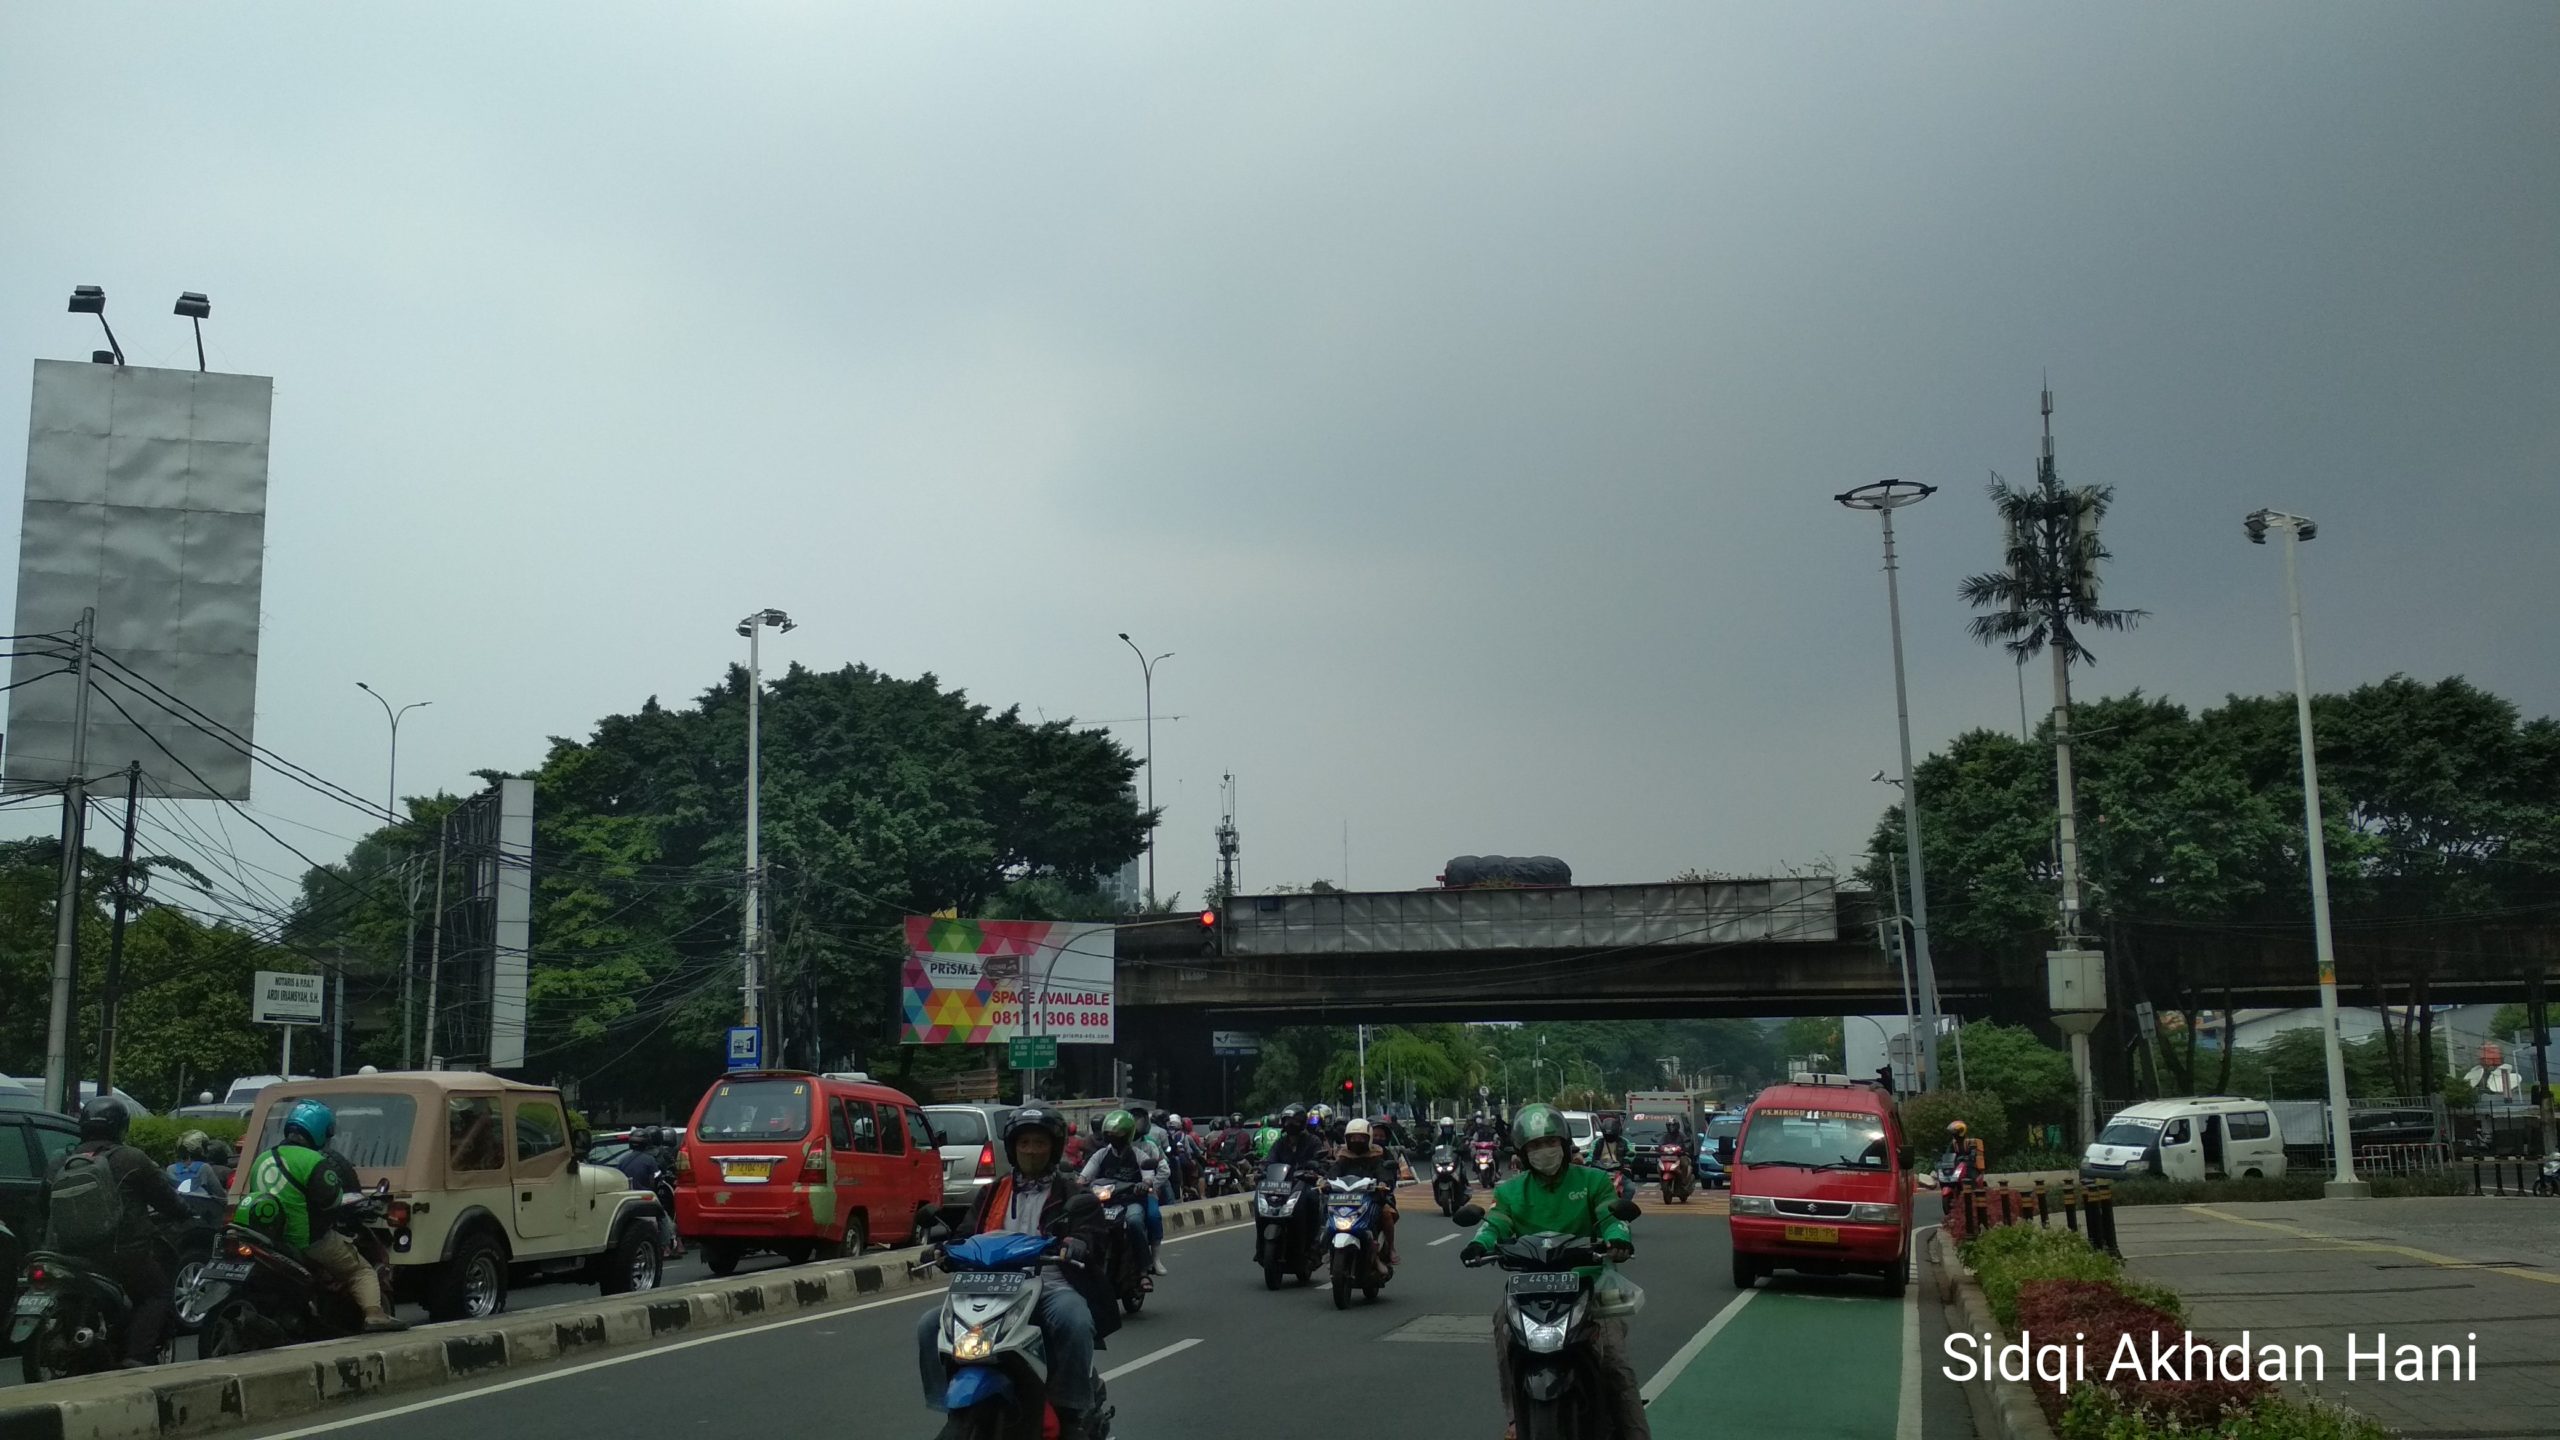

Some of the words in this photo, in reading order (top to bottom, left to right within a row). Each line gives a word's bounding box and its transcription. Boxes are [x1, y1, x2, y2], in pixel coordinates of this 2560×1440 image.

[275, 977, 295, 987] NOTARIS
[267, 989, 279, 1001] ARDI
[992, 990, 1035, 1005] SPACE
[1038, 992, 1110, 1006] AVAILABLE
[1047, 1011, 1075, 1026] 306
[1081, 1012, 1109, 1027] 888
[1812, 1074, 1827, 1084] 11
[721, 1087, 729, 1096] 11
[794, 1085, 803, 1095] 11
[1806, 1109, 1820, 1120] 11
[954, 1274, 962, 1283] B
[967, 1274, 996, 1283] 3939
